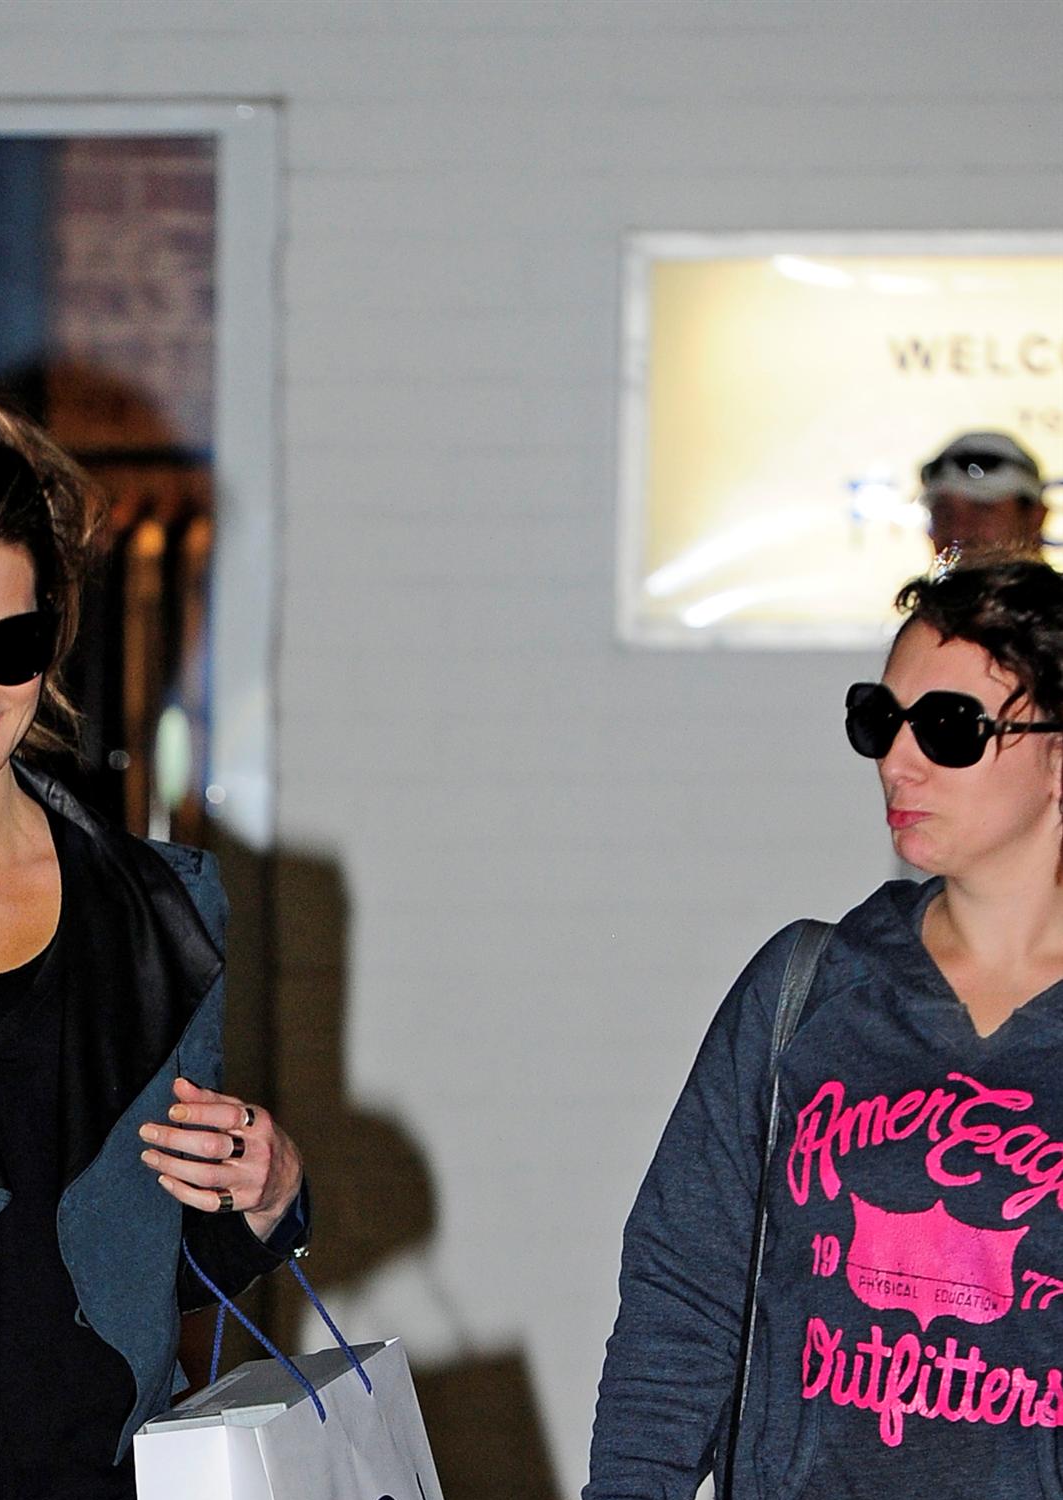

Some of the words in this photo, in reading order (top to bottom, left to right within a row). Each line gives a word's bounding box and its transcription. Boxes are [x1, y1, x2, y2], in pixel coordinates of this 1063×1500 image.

[888, 333, 1063, 376] WELC
[811, 1234, 840, 1276] 19
[858, 1274, 918, 1299] PHYSICAL
